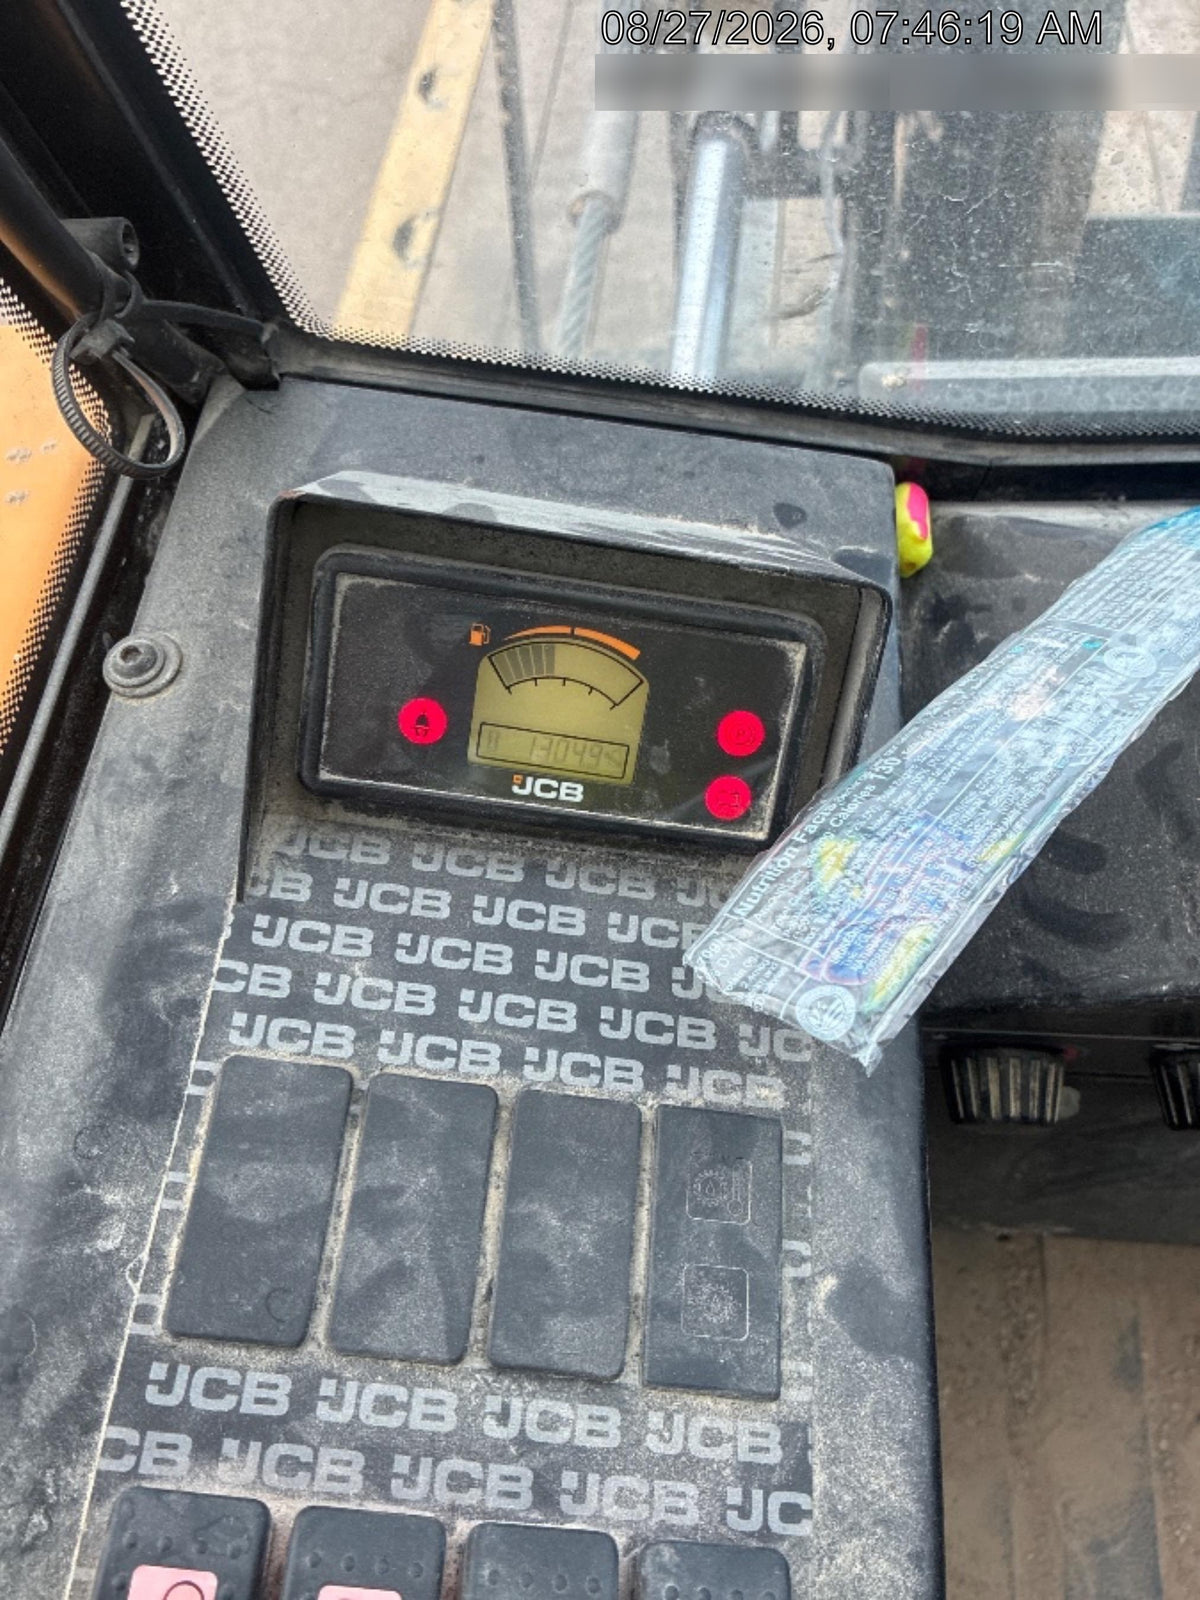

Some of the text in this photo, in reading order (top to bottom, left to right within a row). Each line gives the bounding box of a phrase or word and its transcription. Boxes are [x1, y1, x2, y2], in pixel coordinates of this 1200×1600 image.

[511, 774, 584, 802] JCB
[829, 783, 877, 828] Calories
[868, 754, 903, 781] 130
[333, 877, 452, 919] JCB
[472, 894, 586, 936] JCB
[411, 842, 524, 882] JCB
[545, 862, 656, 899] JCB
[732, 847, 800, 917] Nutrition
[251, 913, 374, 957] JCB
[394, 932, 512, 975] JCB
[534, 948, 650, 992] JCB
[313, 972, 436, 1016] JCB
[458, 988, 577, 1033] JCB
[599, 1005, 716, 1050] JCB
[228, 1011, 787, 1109] JCB JCB JCB JCB
[145, 1361, 783, 1465] JCB JCB JCB JCB
[218, 1438, 366, 1494] JCB
[390, 1454, 534, 1511] JCB
[558, 1470, 700, 1526] JCB
